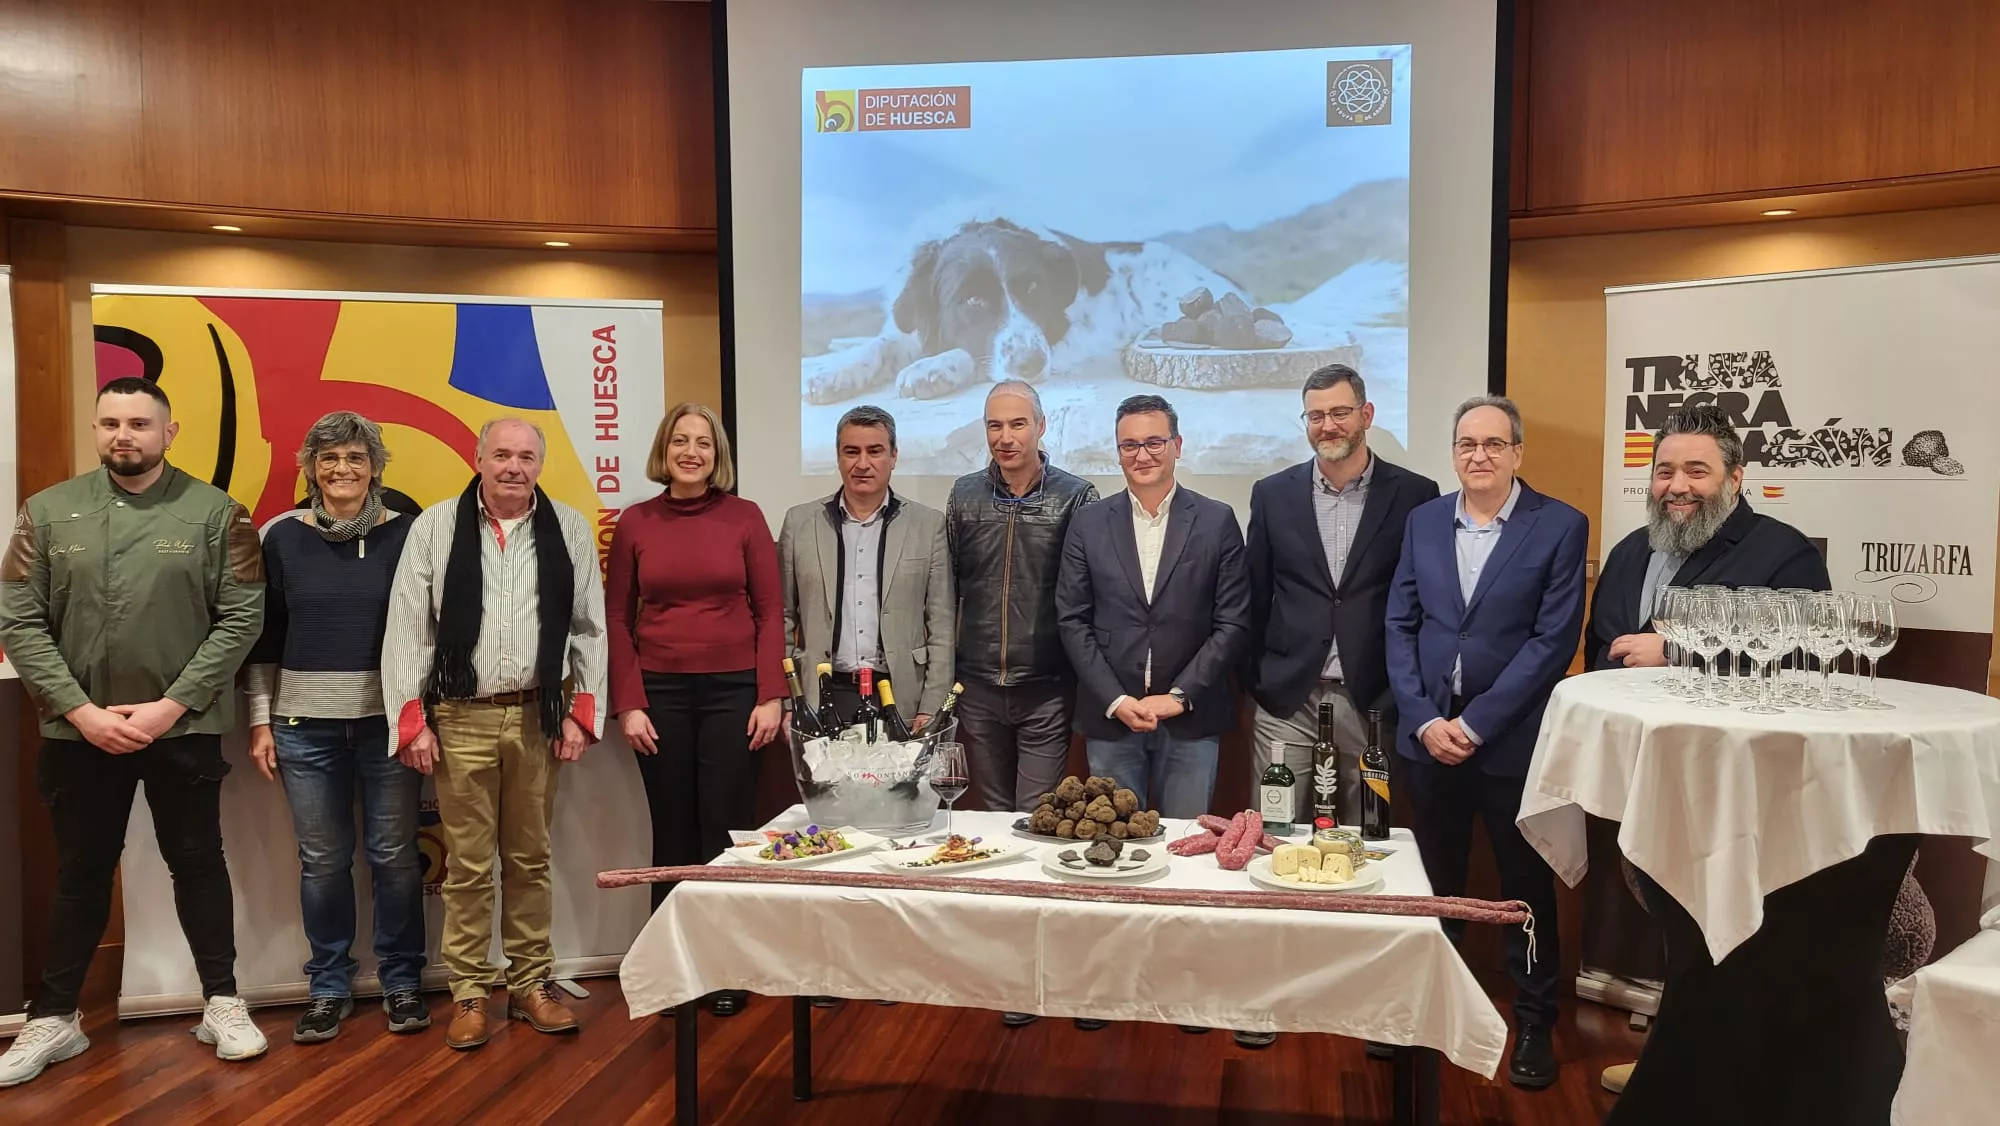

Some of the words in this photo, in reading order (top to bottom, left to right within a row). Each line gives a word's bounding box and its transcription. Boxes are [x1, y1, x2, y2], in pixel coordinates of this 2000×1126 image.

[865, 90, 956, 109] DIPUTACIÓN
[865, 113, 886, 126] DE
[890, 111, 956, 125] HUESCA
[592, 324, 619, 441] HUESCA
[1625, 350, 1782, 393] TRUFA
[596, 455, 620, 493] DE
[1861, 542, 1974, 576] TRUZARFA
